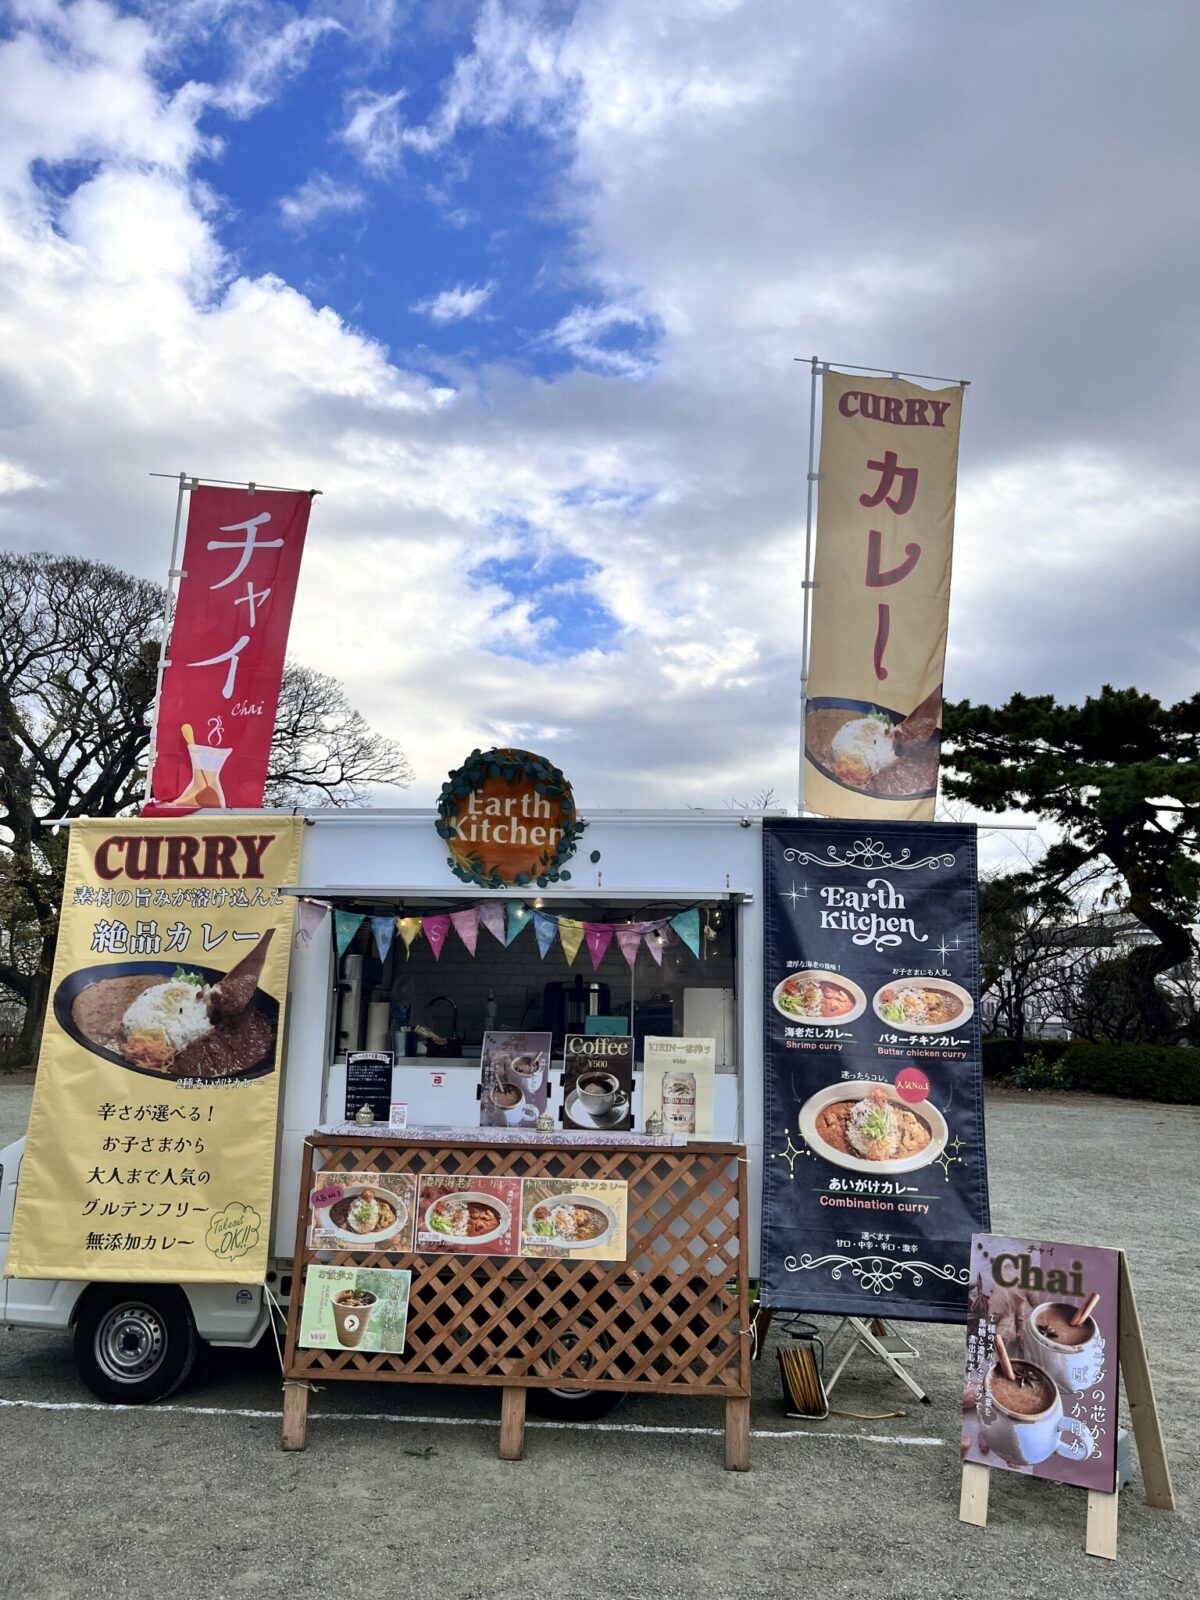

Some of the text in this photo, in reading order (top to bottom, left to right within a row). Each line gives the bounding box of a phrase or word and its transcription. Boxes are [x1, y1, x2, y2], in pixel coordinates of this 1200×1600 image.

[838, 390, 951, 427] CURRY
[859, 450, 921, 681] カレー
[186, 511, 285, 699] チャイ
[231, 700, 264, 717] Chai
[468, 789, 551, 819] Earth
[450, 815, 566, 846] Kitchen
[94, 834, 276, 881] CURRY
[820, 878, 906, 912] Earth
[91, 918, 261, 955] 絶品カレー
[820, 911, 929, 953] Kitchen
[892, 968, 952, 977] お子さまにも人気。
[784, 1027, 853, 1039] 海老だしカレー
[879, 1033, 970, 1046] バターチキンカレー
[569, 1036, 629, 1056] Coffee
[786, 1041, 843, 1051] Shrimp curry
[877, 1047, 967, 1059] Butter chicken curry
[588, 1060, 608, 1069] ¥500
[841, 1070, 889, 1083] 迷ったらコレ。
[97, 1102, 215, 1122] 辛さが選べる！
[102, 1136, 205, 1154] お子さまから
[86, 1166, 211, 1186] 大人まで人気の
[828, 1178, 919, 1194] あいがけカレー
[82, 1199, 209, 1217] グルテンフリー
[819, 1196, 930, 1214] Combination curry
[85, 1231, 195, 1251] 無添加カレー
[221, 1226, 251, 1253] OK!!
[861, 1232, 891, 1241] 選べます
[1027, 1245, 1055, 1257] チャイ
[991, 1253, 1085, 1297] Chai
[1090, 1335, 1107, 1459] カラダの芯から
[1069, 1366, 1089, 1454] ぽっかぽか
